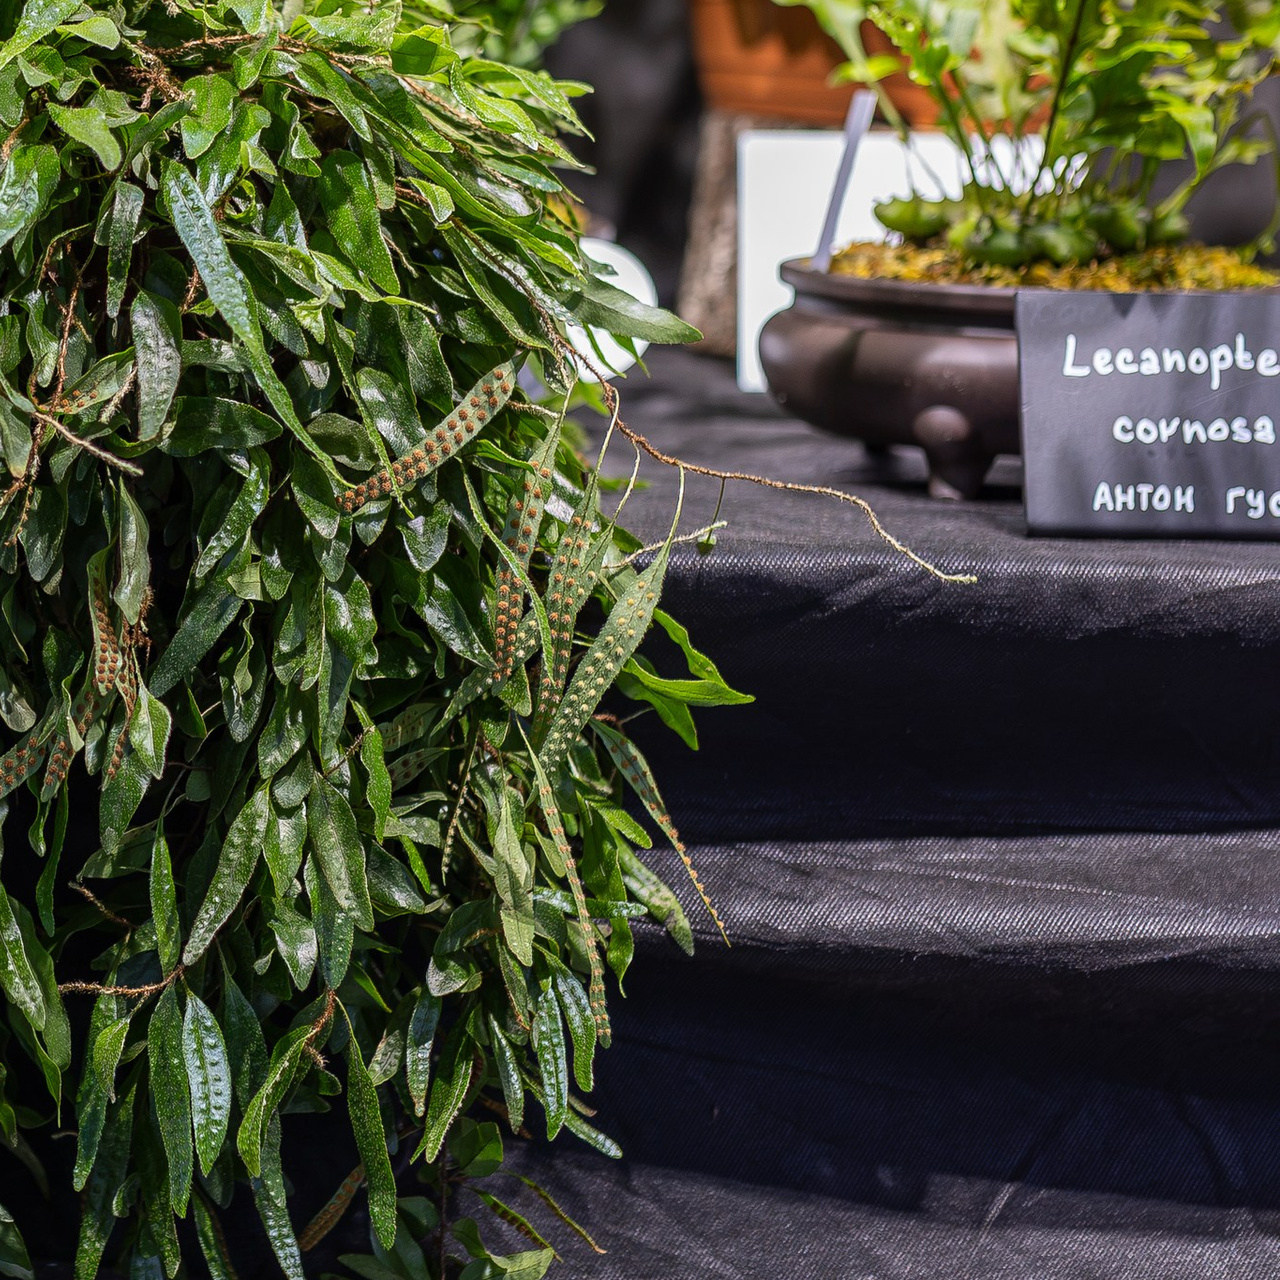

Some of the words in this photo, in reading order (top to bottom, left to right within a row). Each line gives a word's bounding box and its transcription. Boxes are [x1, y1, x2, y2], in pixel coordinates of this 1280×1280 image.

[1062, 332, 1280, 391] Lecanopte
[1113, 415, 1276, 445] cornosa
[1092, 481, 1195, 514] АНТОН
